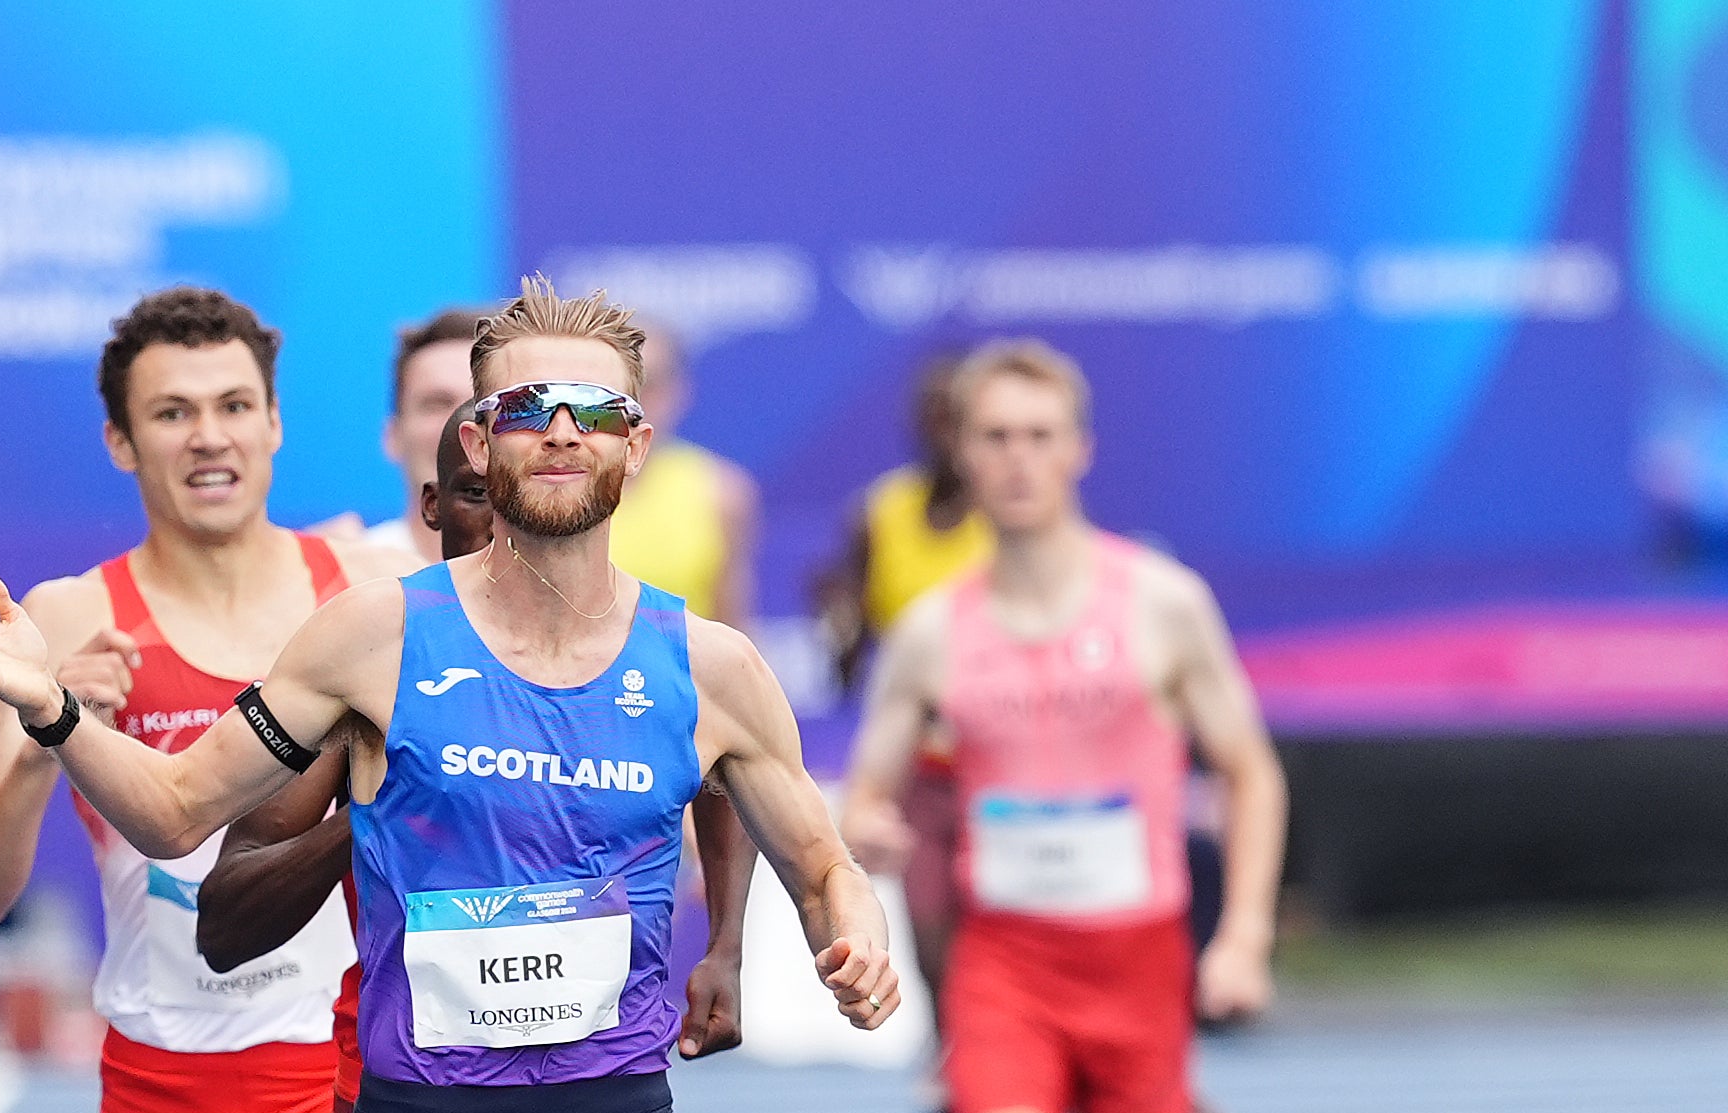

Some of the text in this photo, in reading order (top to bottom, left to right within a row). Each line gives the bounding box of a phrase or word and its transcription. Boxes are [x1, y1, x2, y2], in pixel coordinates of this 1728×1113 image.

[247, 704, 294, 759] amazfit
[441, 744, 654, 793] SCOTLAND
[479, 953, 565, 984] KERR
[469, 1003, 584, 1026] LONGINES
